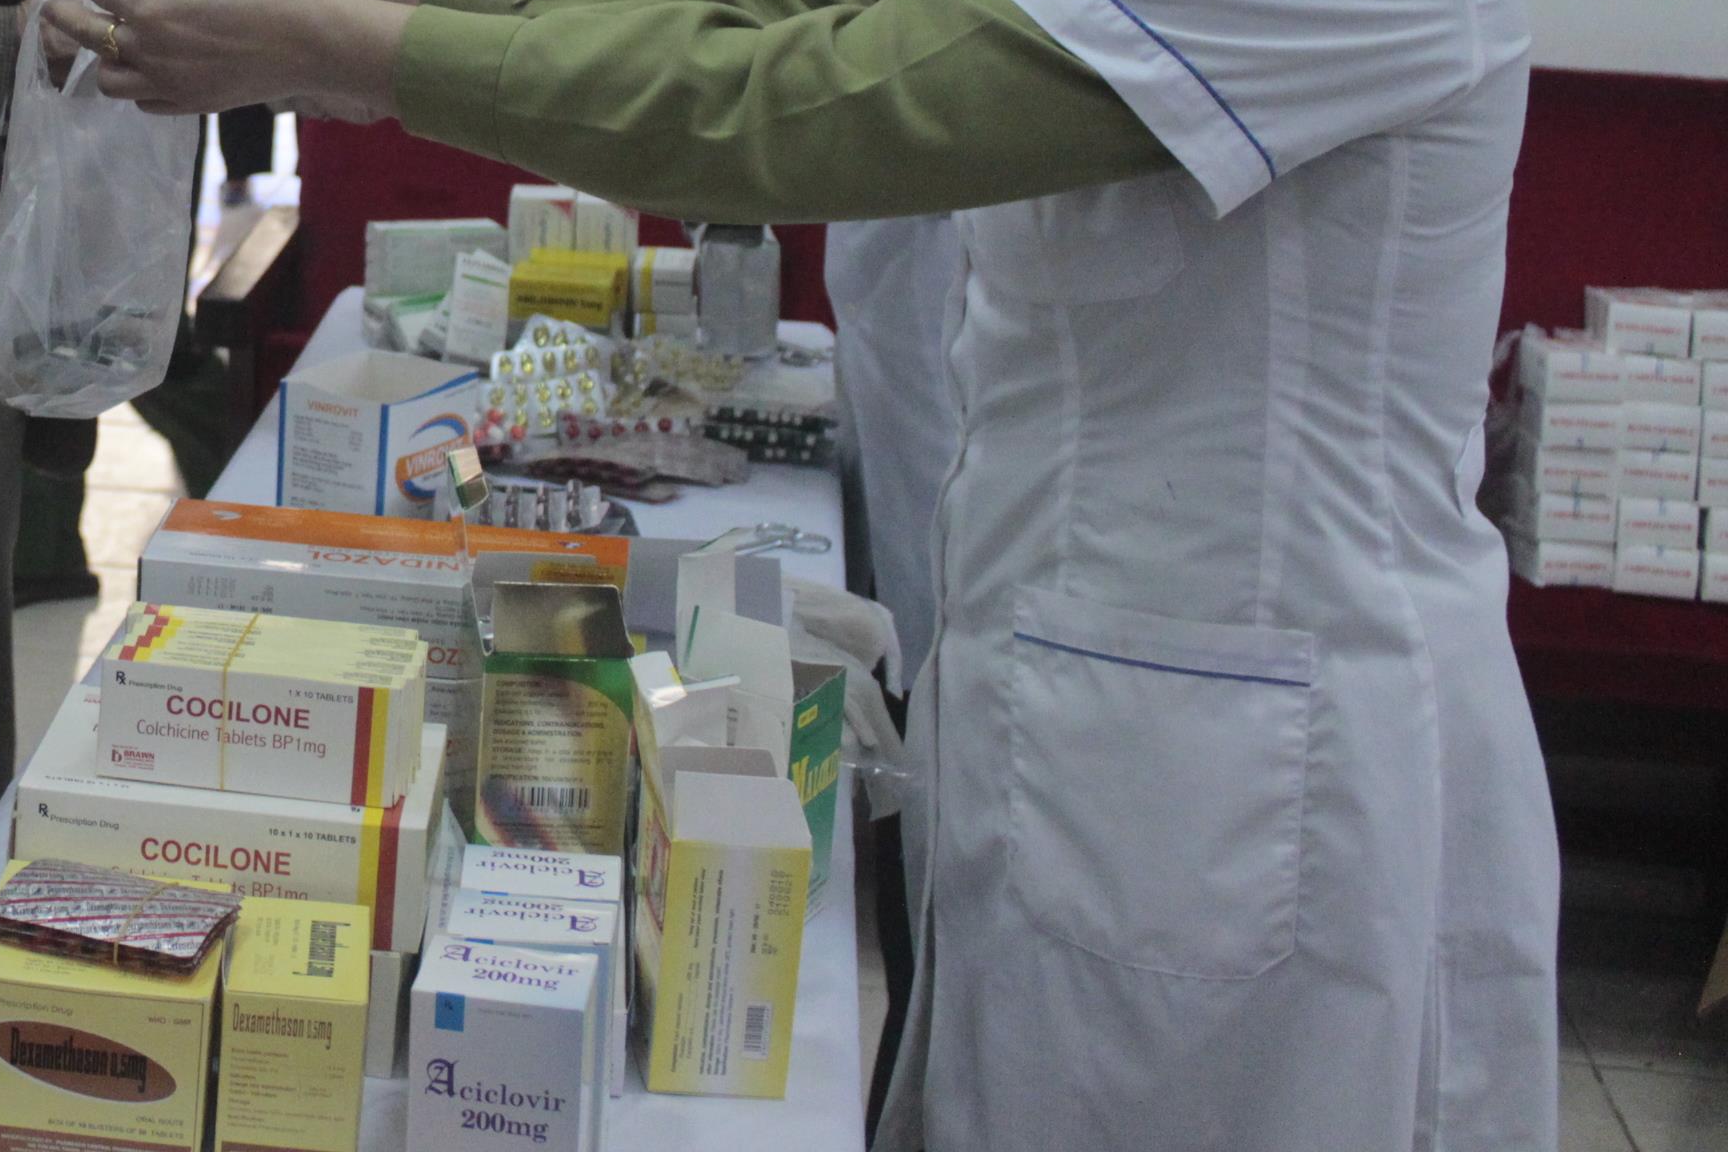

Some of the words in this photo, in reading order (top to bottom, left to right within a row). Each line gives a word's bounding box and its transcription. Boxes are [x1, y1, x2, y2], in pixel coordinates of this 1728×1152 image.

[166, 694, 311, 730] COCILONE
[315, 692, 354, 704] TABLETS
[136, 719, 210, 741] Colchicine
[215, 727, 267, 748] Tablets
[50, 813, 97, 828] Prescription
[99, 819, 120, 831] Drug
[315, 833, 356, 845] TABLETS
[140, 836, 292, 876] COCILONE
[476, 860, 606, 888] Aciclovir
[464, 907, 599, 933] Aciclovir
[440, 944, 580, 976] Aciclovir
[472, 968, 560, 991] 200mg
[232, 1003, 305, 1039] Dexamethason
[10, 1026, 109, 1077] Dexamethason
[425, 1058, 566, 1113] Aciclovir
[461, 1109, 549, 1144] 200mg
